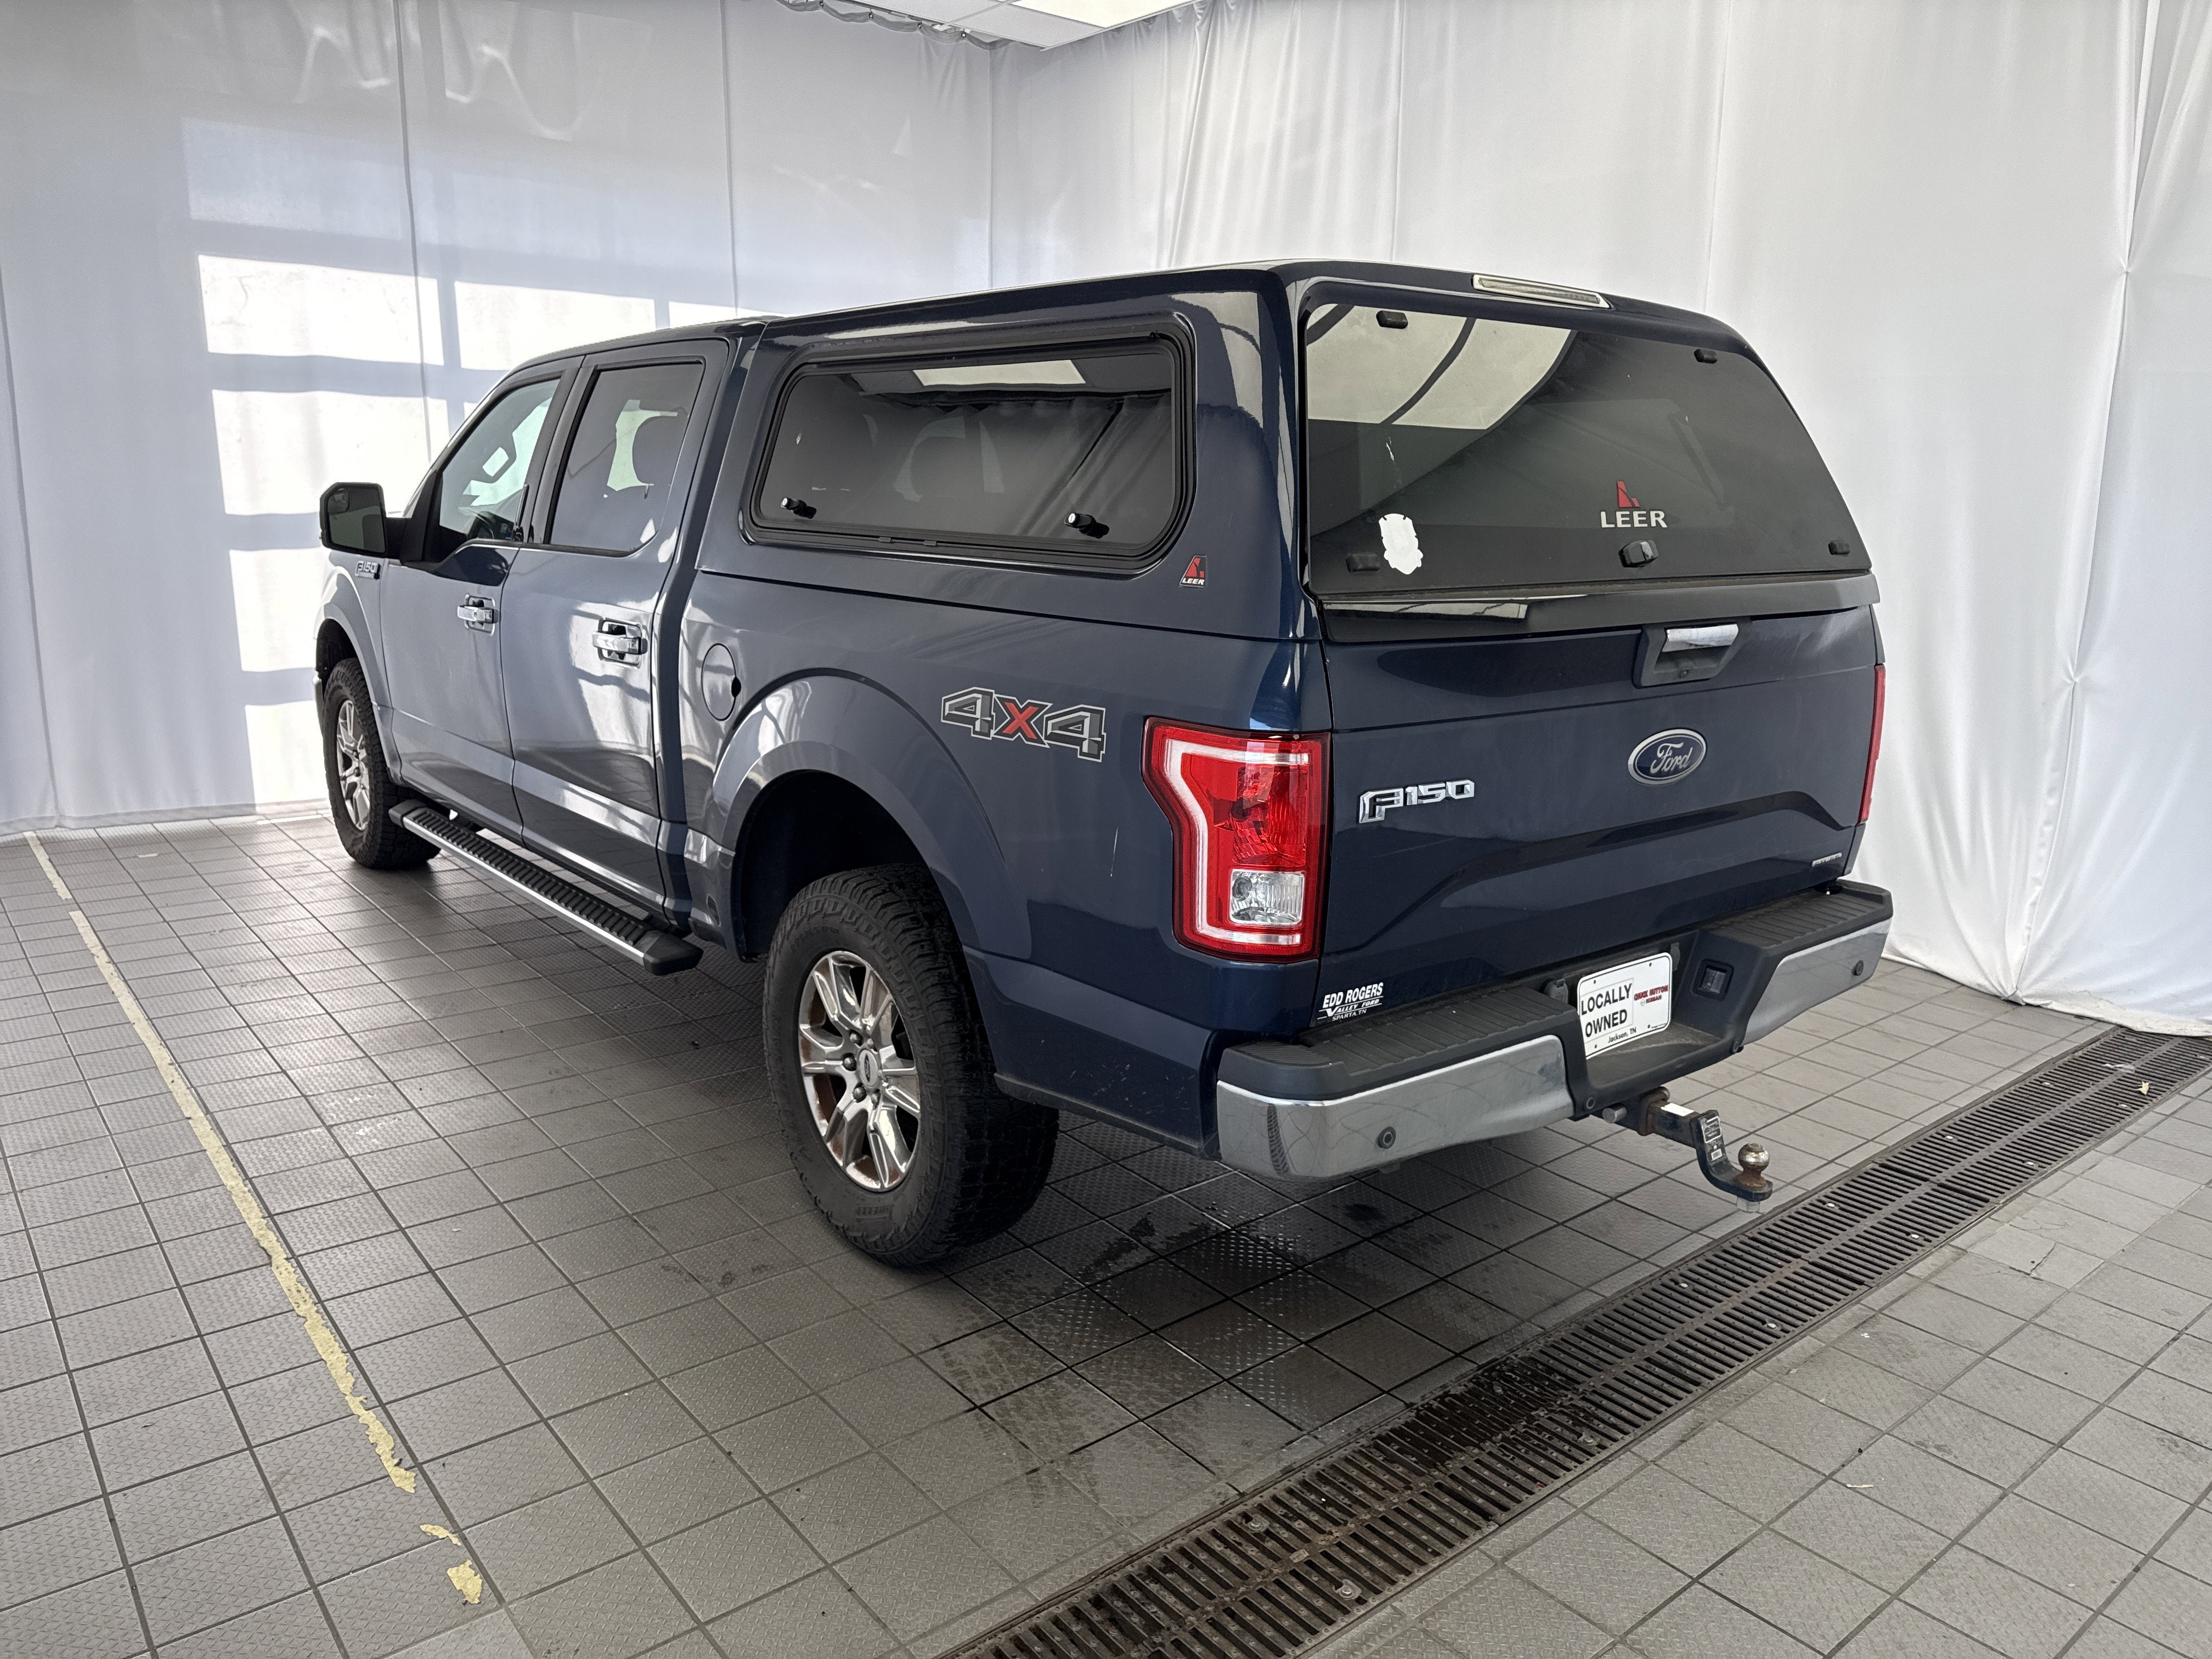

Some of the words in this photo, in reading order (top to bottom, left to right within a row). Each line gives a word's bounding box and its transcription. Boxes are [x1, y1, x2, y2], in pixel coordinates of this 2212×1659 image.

[1600, 510, 1668, 528] LEER
[354, 560, 379, 577] F150
[1650, 742, 1693, 774] Ford
[1358, 778, 1475, 823] F150
[1322, 991, 1344, 1008] EDD
[1345, 982, 1384, 1003] ROGERS
[1325, 1003, 1359, 1017] VALLEY
[1361, 998, 1380, 1008] FORD
[1581, 983, 1632, 1016] LOCALLY
[1585, 1009, 1628, 1037] OWNED
[1608, 1031, 1628, 1043] Jackson,
[1629, 1027, 1637, 1035] TN
